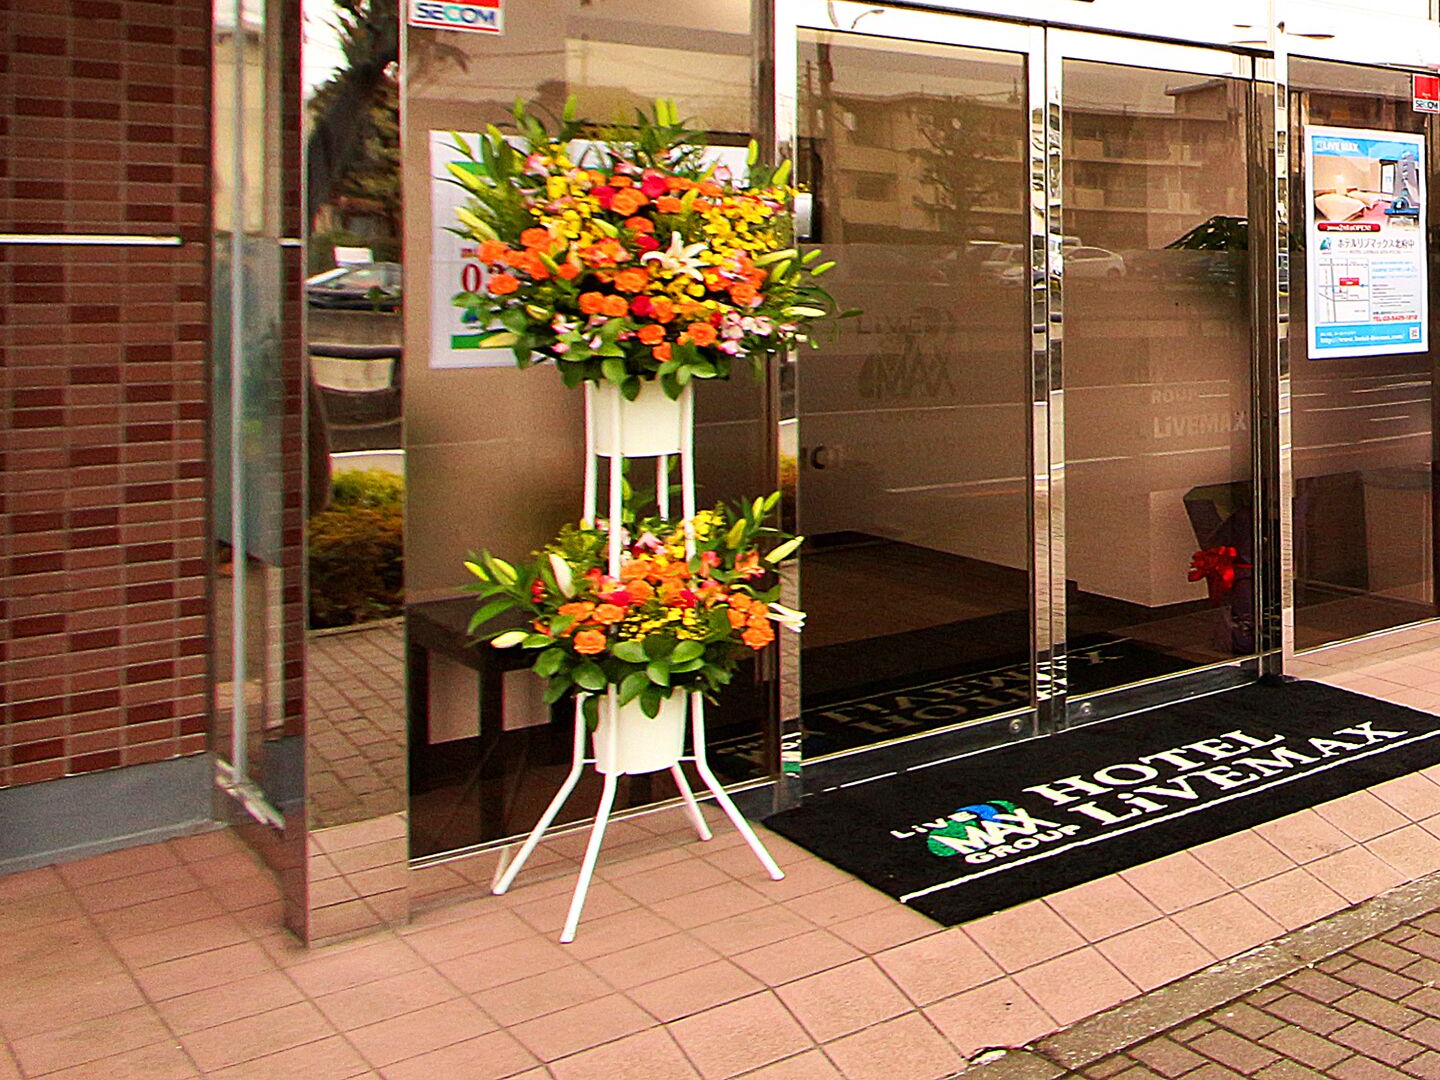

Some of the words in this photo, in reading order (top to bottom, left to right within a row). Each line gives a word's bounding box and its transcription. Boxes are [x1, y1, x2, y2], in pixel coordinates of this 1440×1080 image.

[415, 2, 496, 26] SECOM
[1022, 729, 1286, 806] HOTEL
[934, 808, 1062, 856] MAX
[964, 824, 1081, 865] GROUP
